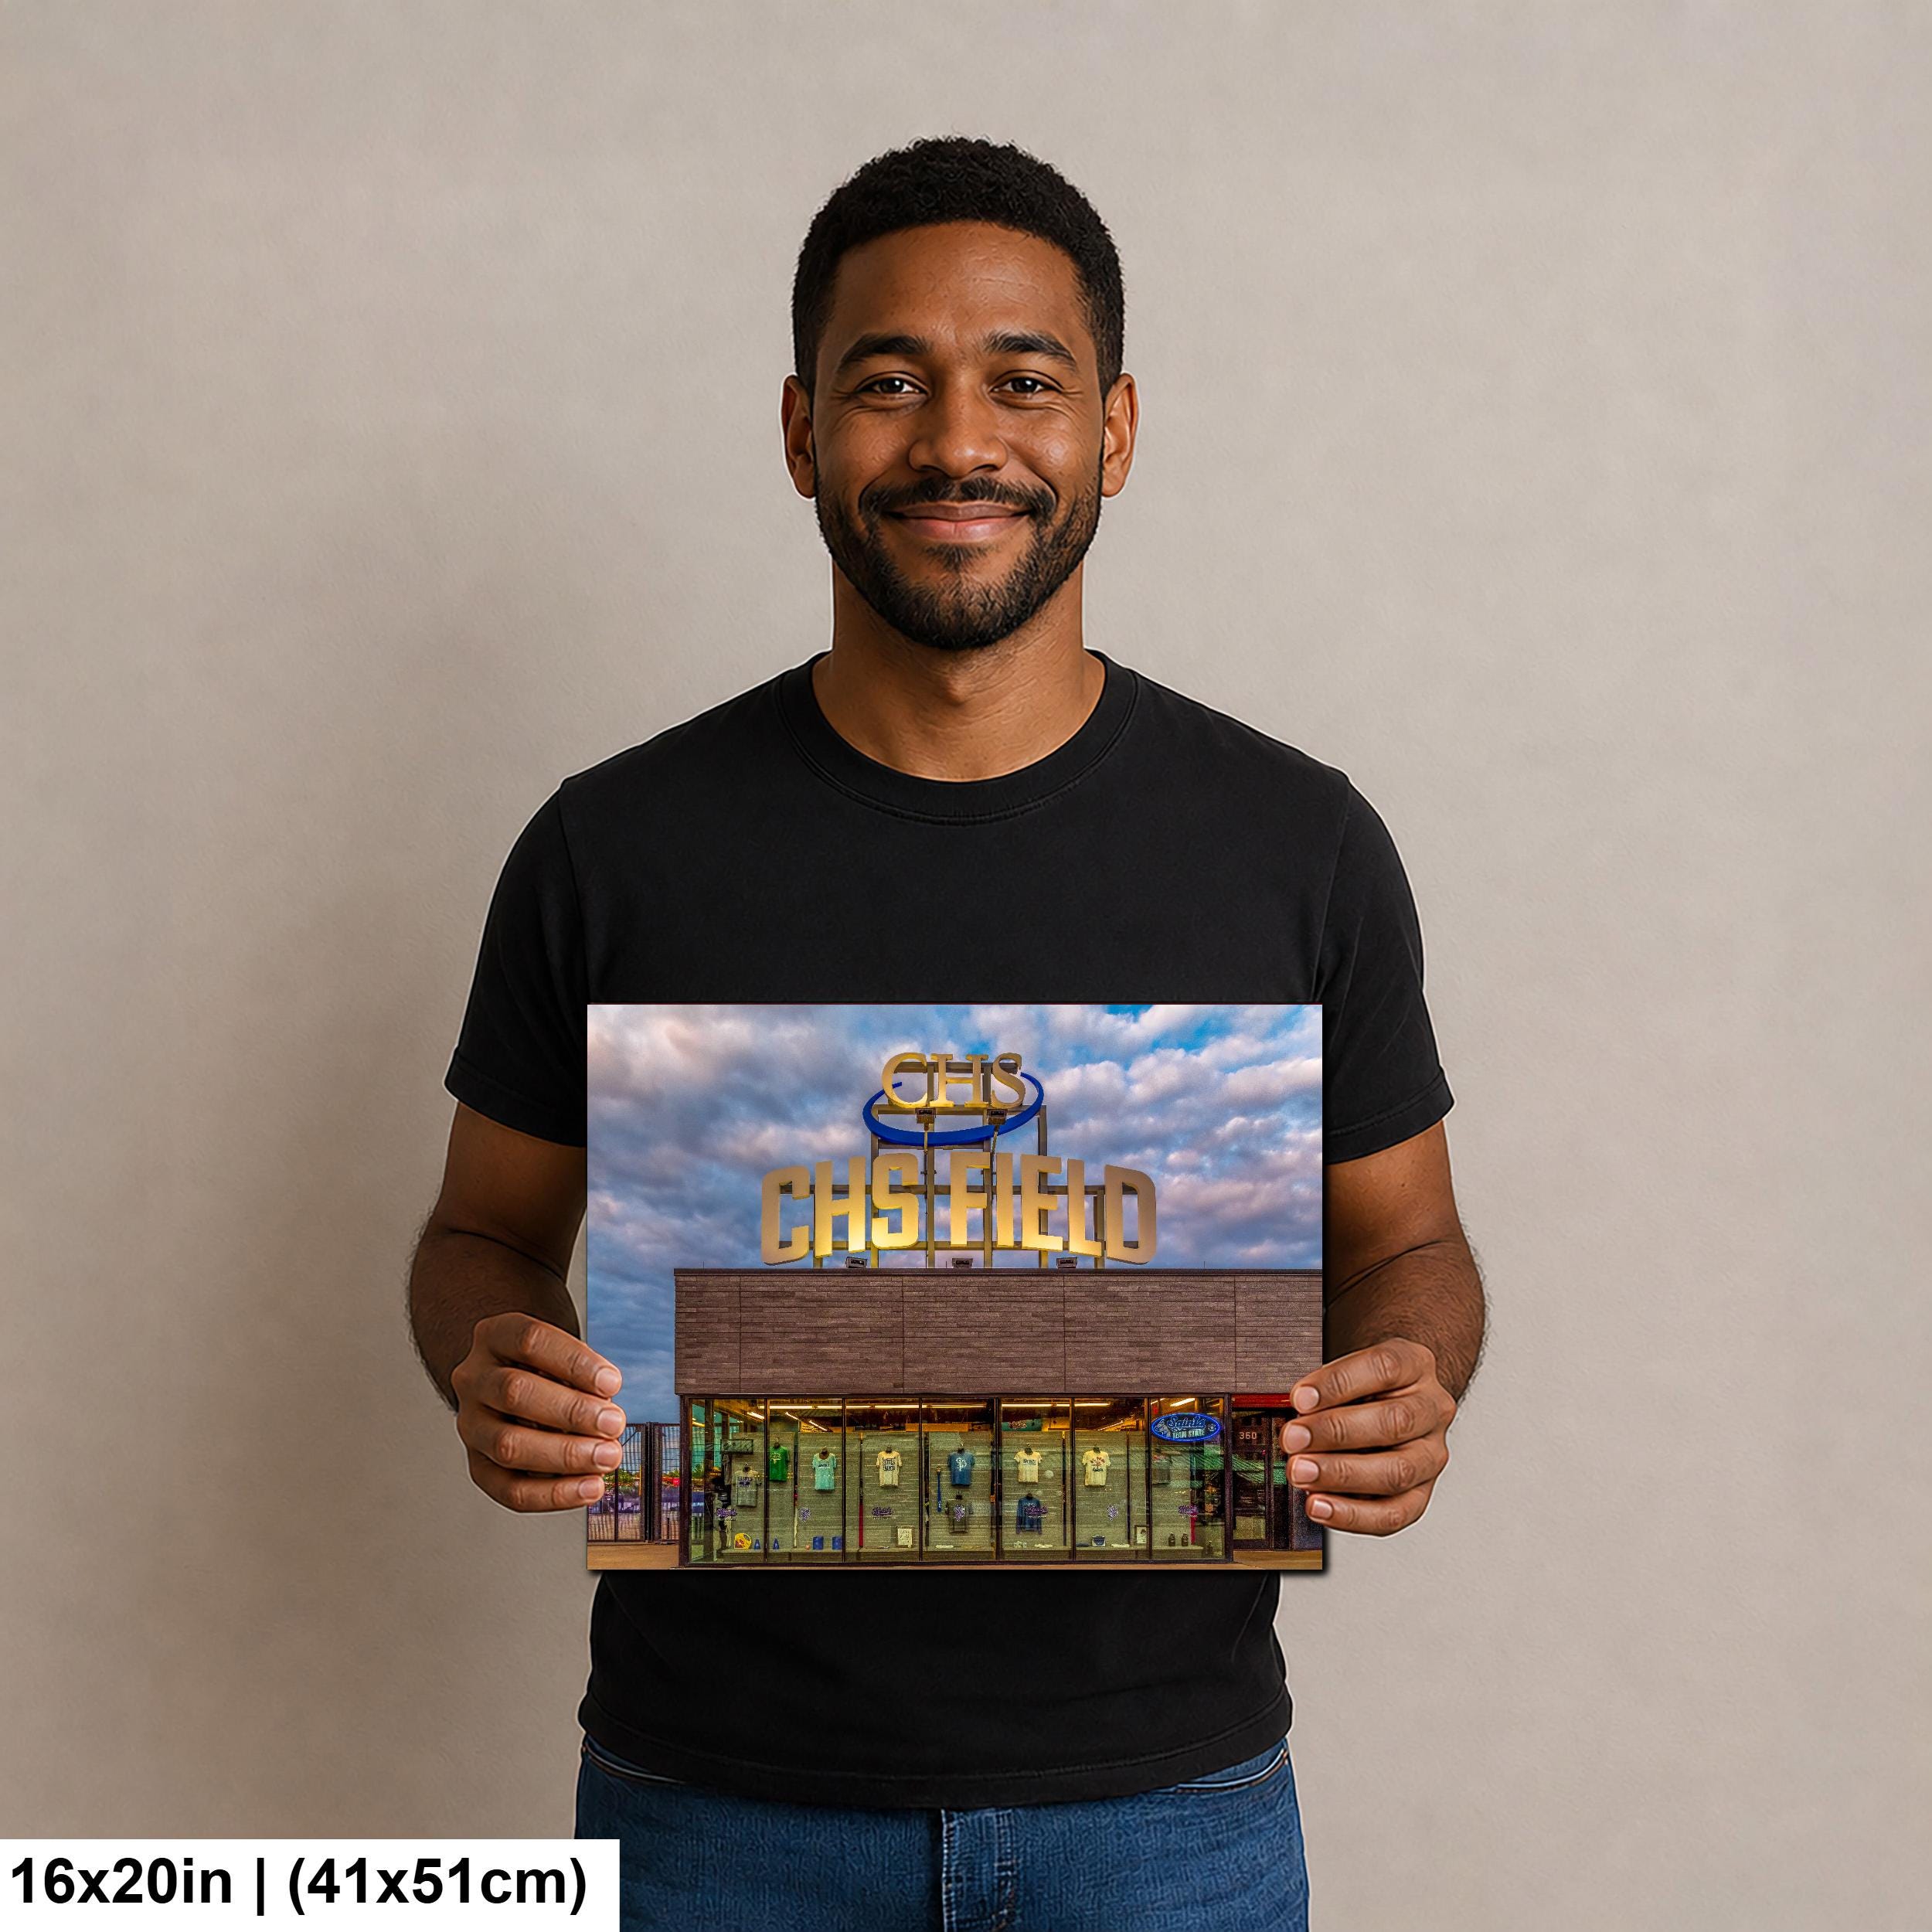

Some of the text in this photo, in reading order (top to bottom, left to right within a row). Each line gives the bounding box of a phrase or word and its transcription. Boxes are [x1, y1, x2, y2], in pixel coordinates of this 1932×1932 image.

[881, 1052, 1026, 1108] CHS
[761, 1151, 1157, 1266] CHS FIELD
[1239, 1431, 1257, 1440] 360
